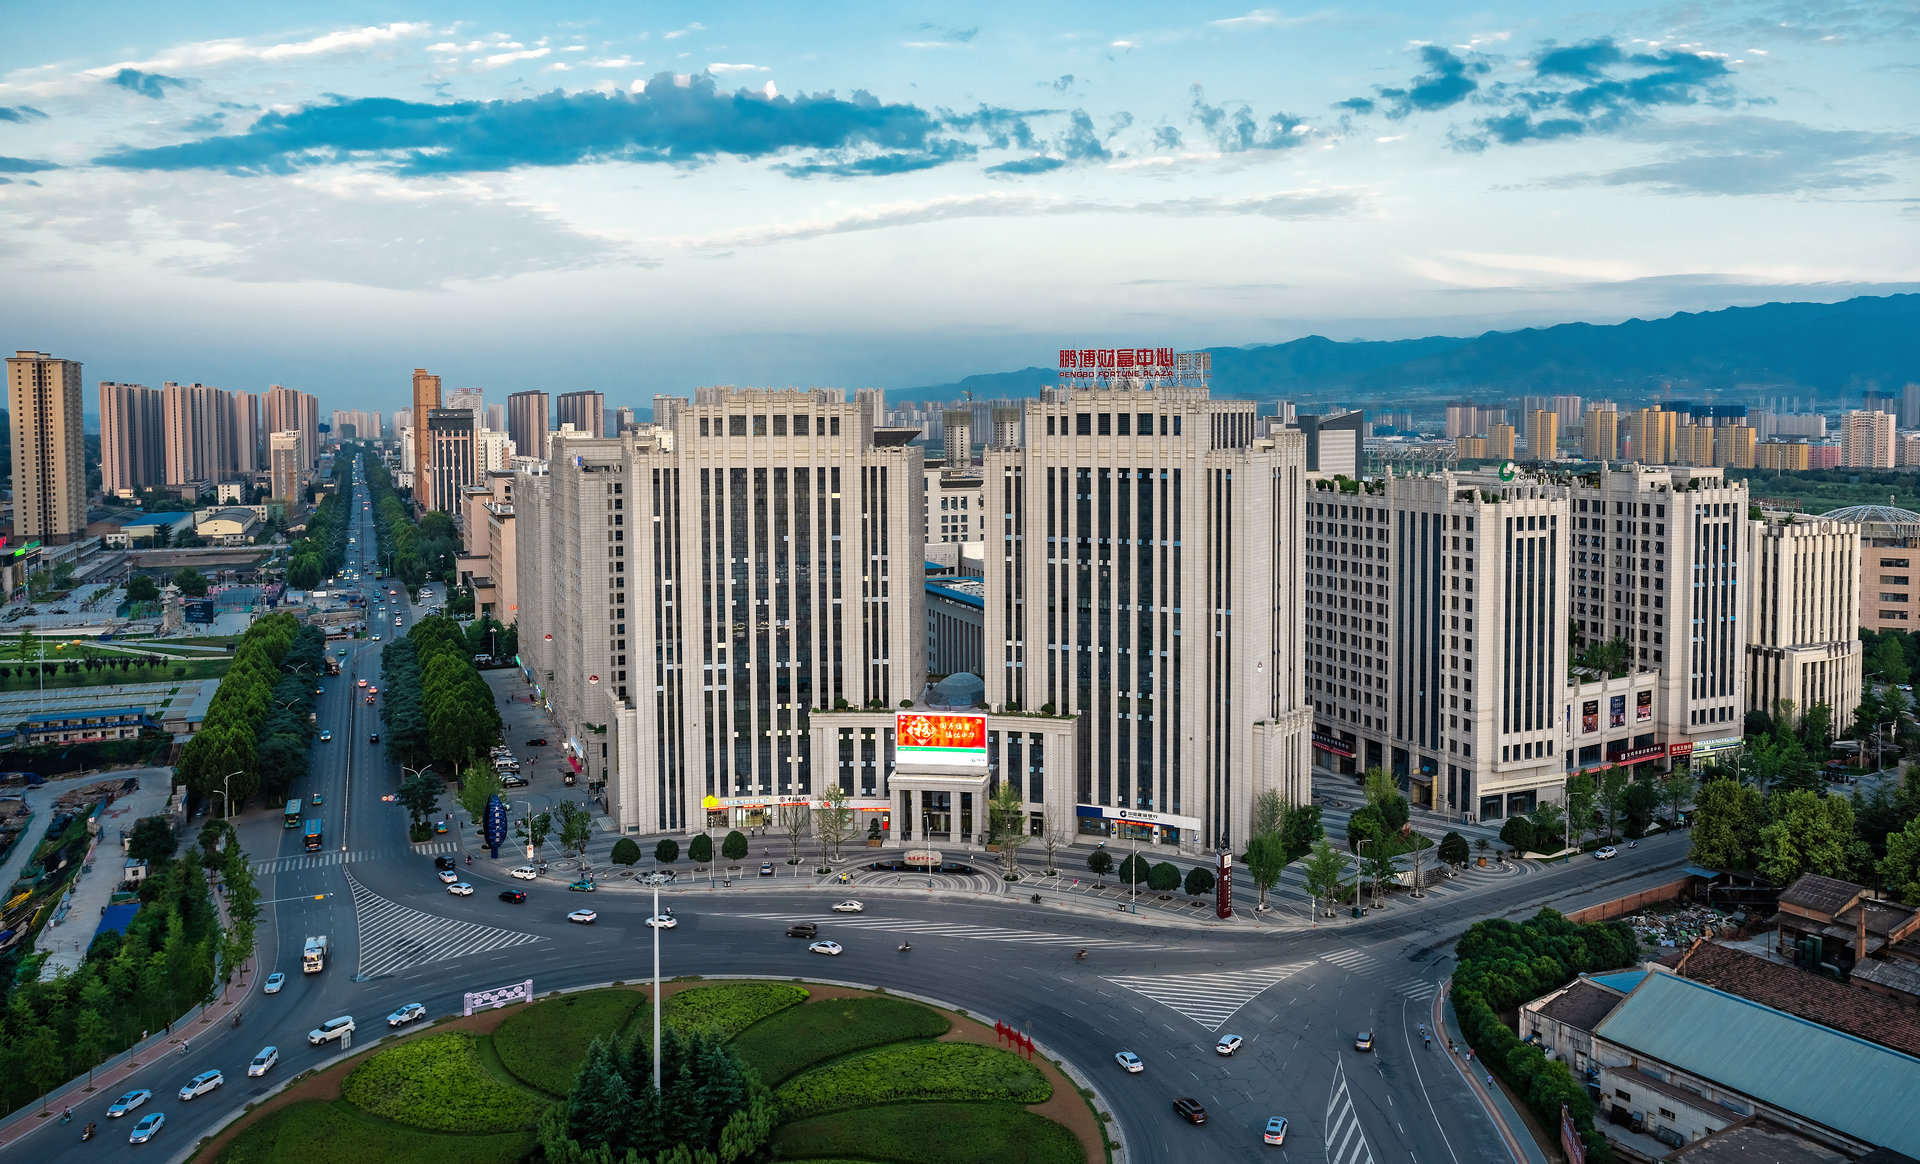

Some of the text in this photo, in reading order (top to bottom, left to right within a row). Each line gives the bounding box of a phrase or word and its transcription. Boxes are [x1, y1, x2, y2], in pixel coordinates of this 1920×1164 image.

[1059, 348, 1174, 368] 鹏博财富中心
[1098, 370, 1140, 378] FORTUNE
